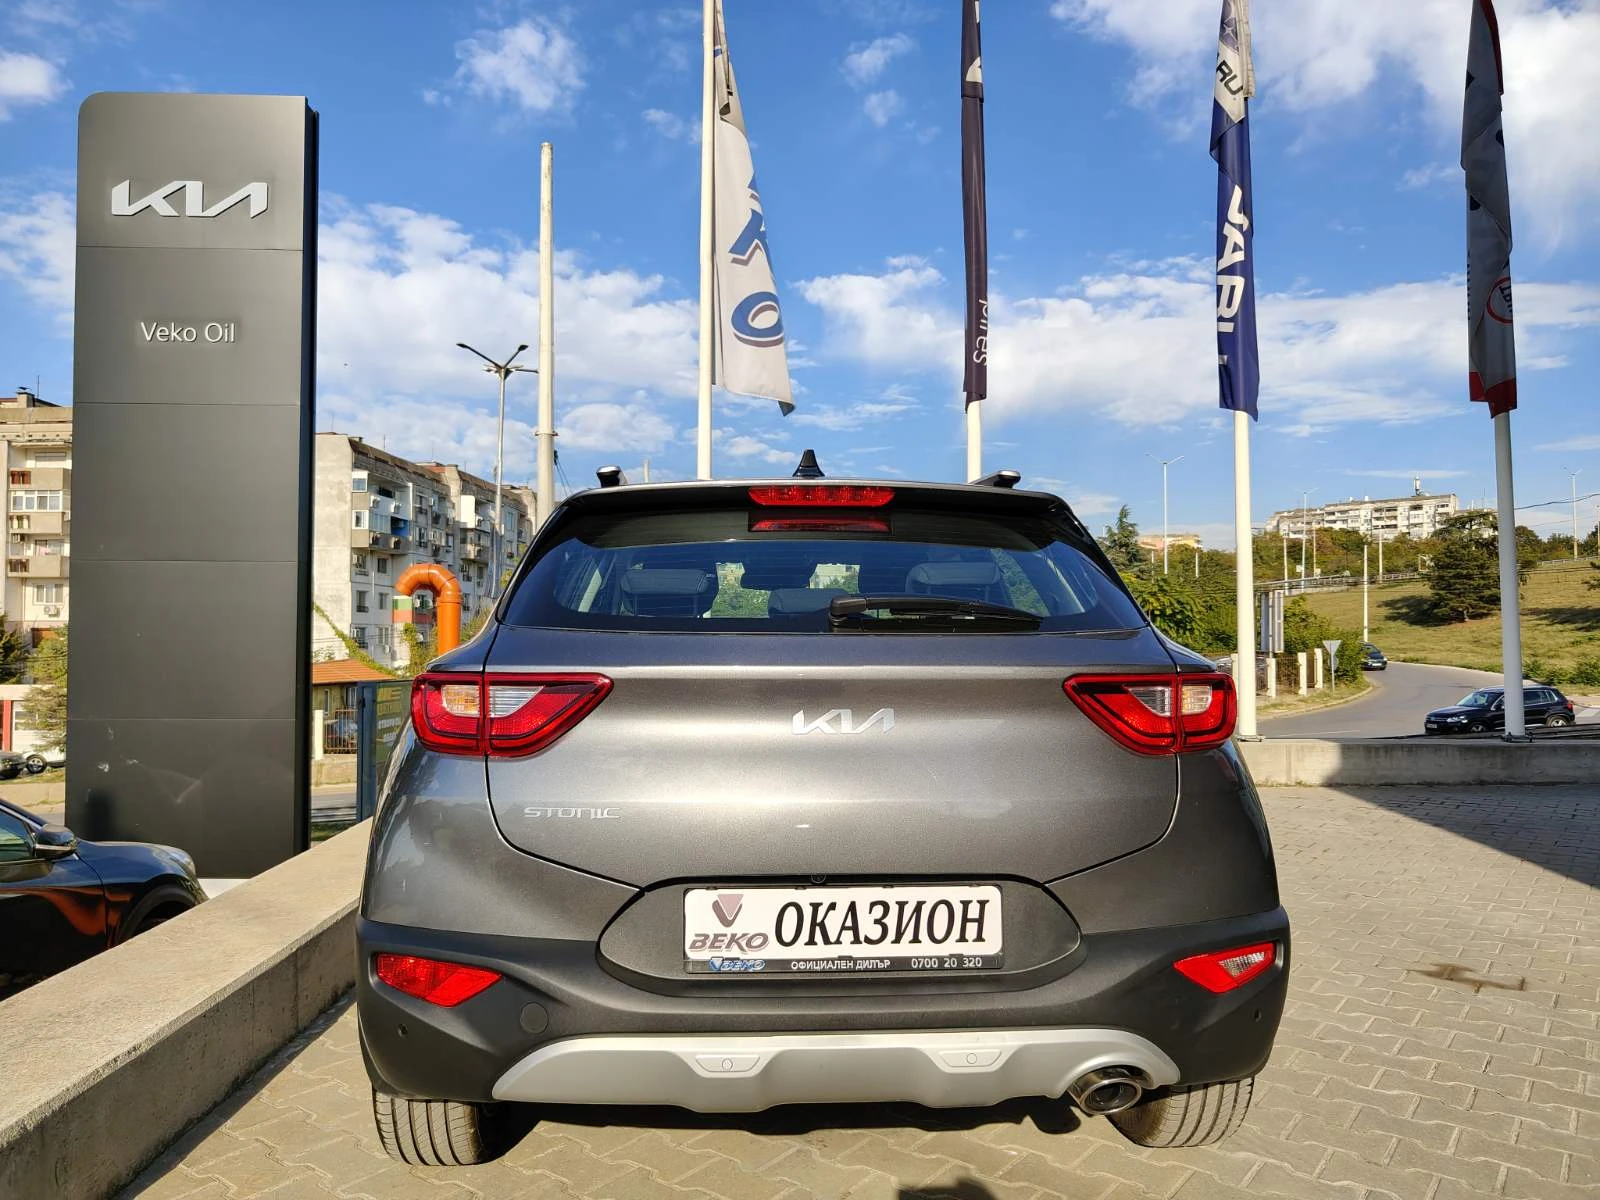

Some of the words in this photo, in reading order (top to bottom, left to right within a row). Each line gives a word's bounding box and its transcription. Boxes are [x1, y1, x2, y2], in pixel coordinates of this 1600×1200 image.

[110, 180, 269, 219] KIA
[140, 322, 197, 344] Veko
[204, 322, 236, 344] Oil
[792, 707, 895, 735] KIA
[524, 807, 621, 819] STONIC
[775, 899, 990, 947] ОКАЗИОН
[791, 959, 853, 970] ОФИЦИАЛЕН
[911, 957, 938, 969] 0700
[943, 957, 957, 969] 20
[962, 957, 982, 969] 320
